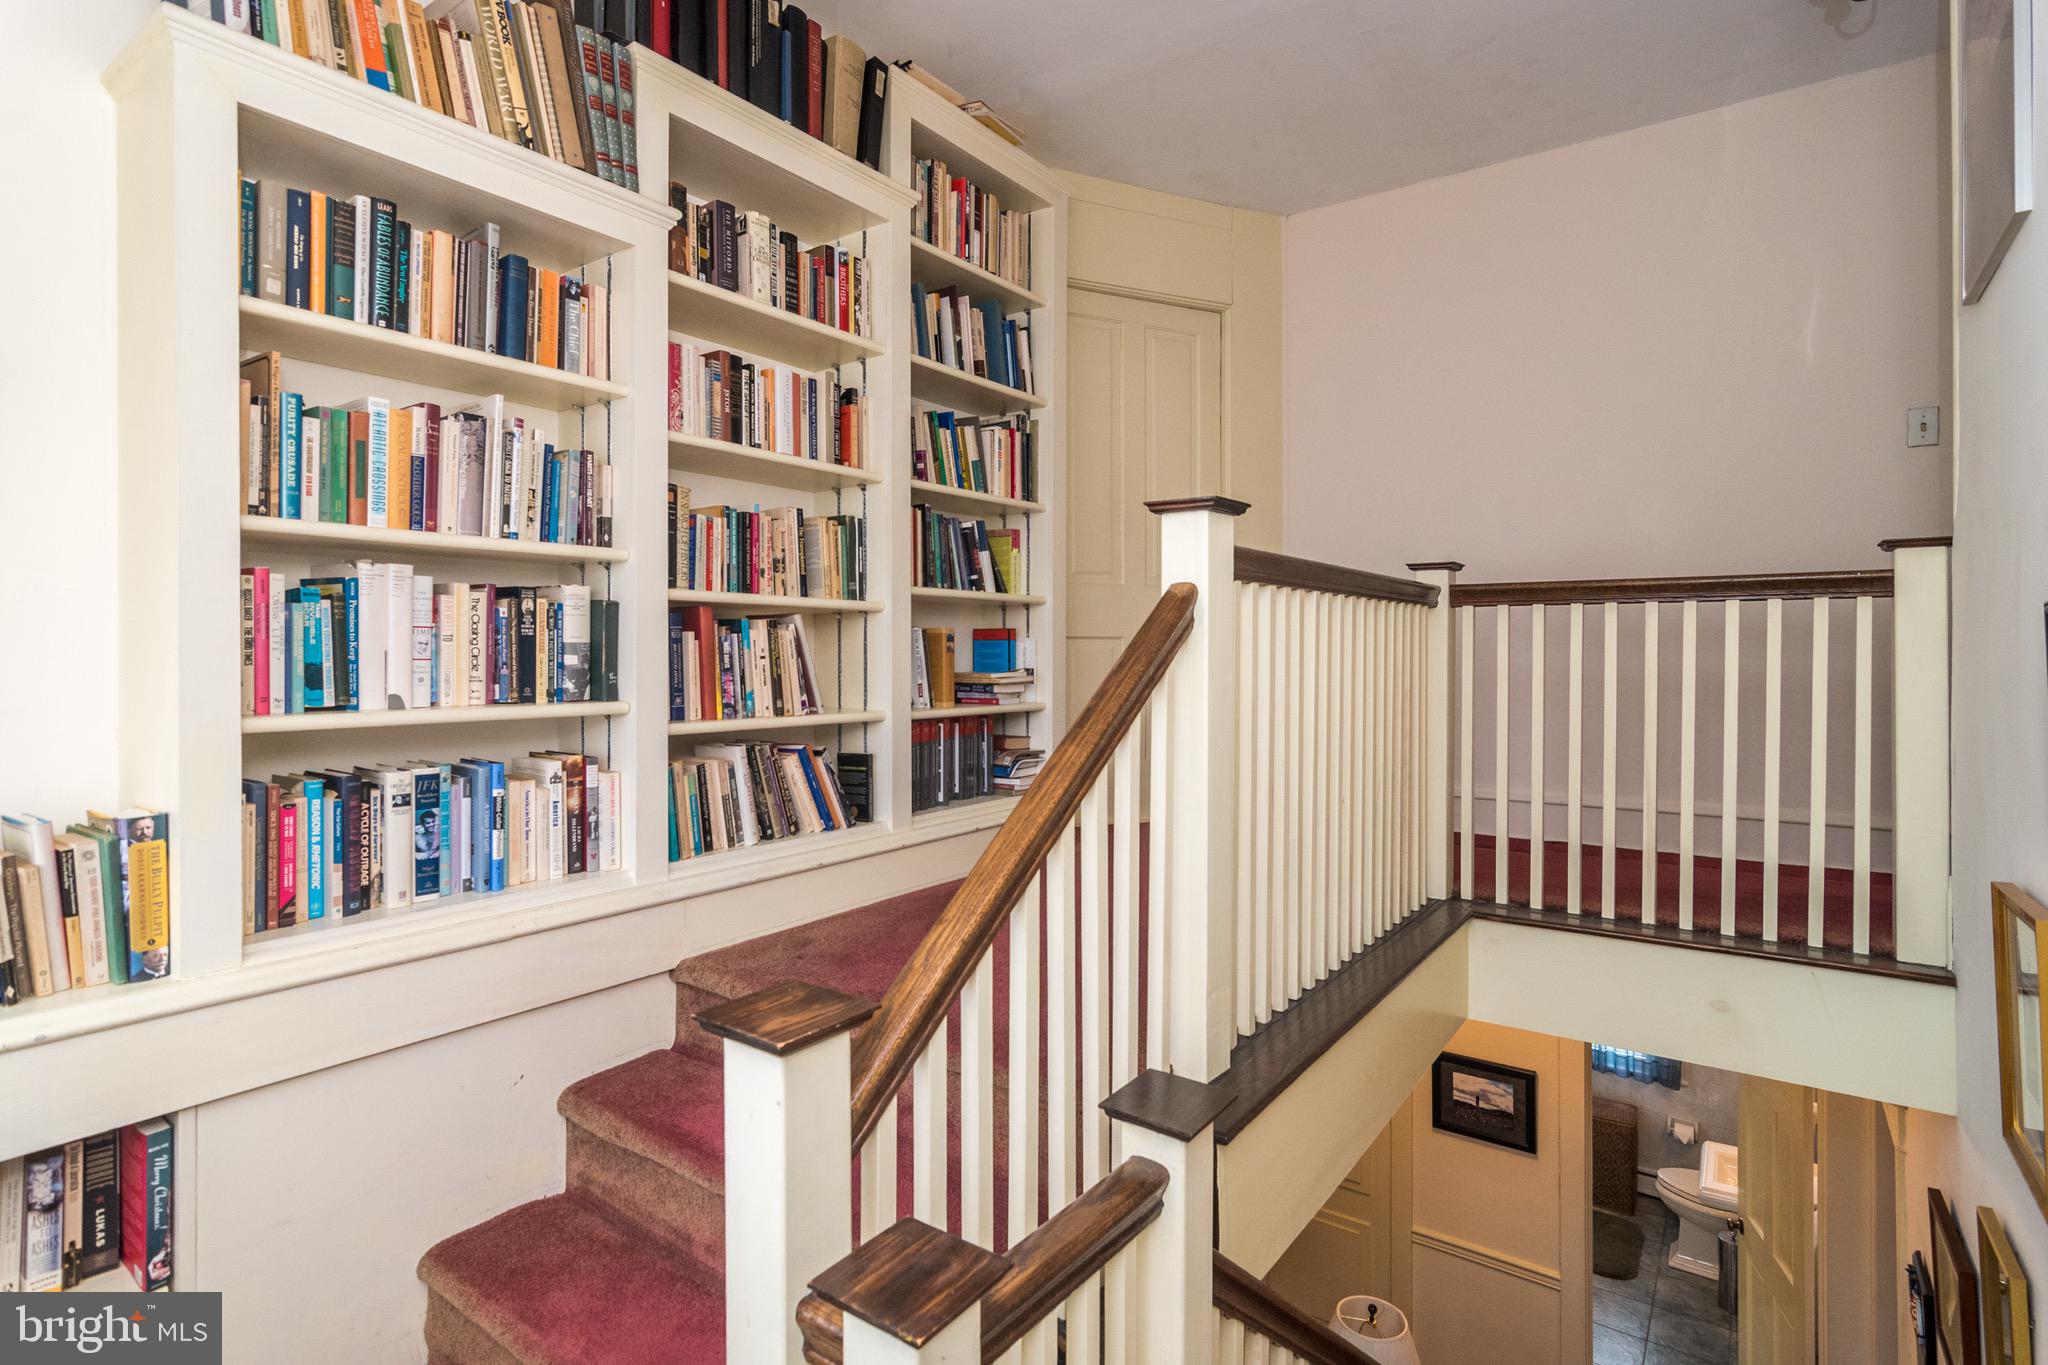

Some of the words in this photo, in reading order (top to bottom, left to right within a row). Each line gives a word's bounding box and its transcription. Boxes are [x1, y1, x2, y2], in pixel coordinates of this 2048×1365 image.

[480, 6, 502, 69] WORLD
[497, 8, 511, 46] BOOK
[496, 77, 511, 112] WAR
[569, 59, 584, 105] Album
[503, 113, 514, 123] I
[377, 202, 392, 213] LEARS
[377, 214, 392, 246] FABLES
[378, 248, 390, 258] OF
[375, 259, 390, 317] ABUNDANCE
[399, 279, 407, 304] Empire
[569, 301, 579, 323] The
[569, 325, 579, 354] Chief
[288, 397, 296, 435] PURITY
[372, 412, 386, 457] ATLANTIC
[398, 420, 407, 455] SOCIAL
[505, 434, 513, 459] SCHMITT
[287, 439, 295, 487] CRUSADE
[414, 457, 421, 471] NO
[372, 461, 386, 512] CROSSINGS
[398, 459, 406, 505] CONTROL
[413, 473, 421, 498] OTHER
[504, 484, 512, 505] NATURE
[681, 490, 688, 500] IN
[681, 535, 688, 545] OF
[244, 588, 252, 606] RUSSELL
[471, 598, 480, 611] The
[244, 607, 252, 621] BAKER
[244, 627, 252, 636] THE
[349, 632, 356, 641] to
[442, 634, 453, 642] TO
[469, 614, 480, 645] Closing
[549, 631, 554, 639] WE
[244, 637, 253, 651] GOOD
[346, 641, 356, 660] Keep
[244, 651, 253, 666] TIMES
[471, 647, 480, 672] Circle
[416, 780, 440, 794] JFK
[311, 799, 320, 835] REASON
[361, 810, 369, 833] CYCLE
[361, 835, 369, 846] OF
[137, 849, 146, 872] DORIS
[151, 845, 161, 865] THE
[311, 844, 320, 889] RHETORIC
[360, 847, 369, 886] OUTRAGE
[151, 868, 162, 898] BULLY
[10, 904, 18, 916] The
[138, 905, 147, 940] GOODWIN
[152, 901, 164, 936] PULPIT
[13, 942, 24, 967] Moment
[153, 1154, 169, 1187] Merry
[31, 1212, 60, 1230] ASHES
[153, 1186, 170, 1232] Christmas!
[39, 1228, 53, 1238] TO
[95, 1208, 106, 1248] LUKAS
[31, 1237, 60, 1256] ASHES
